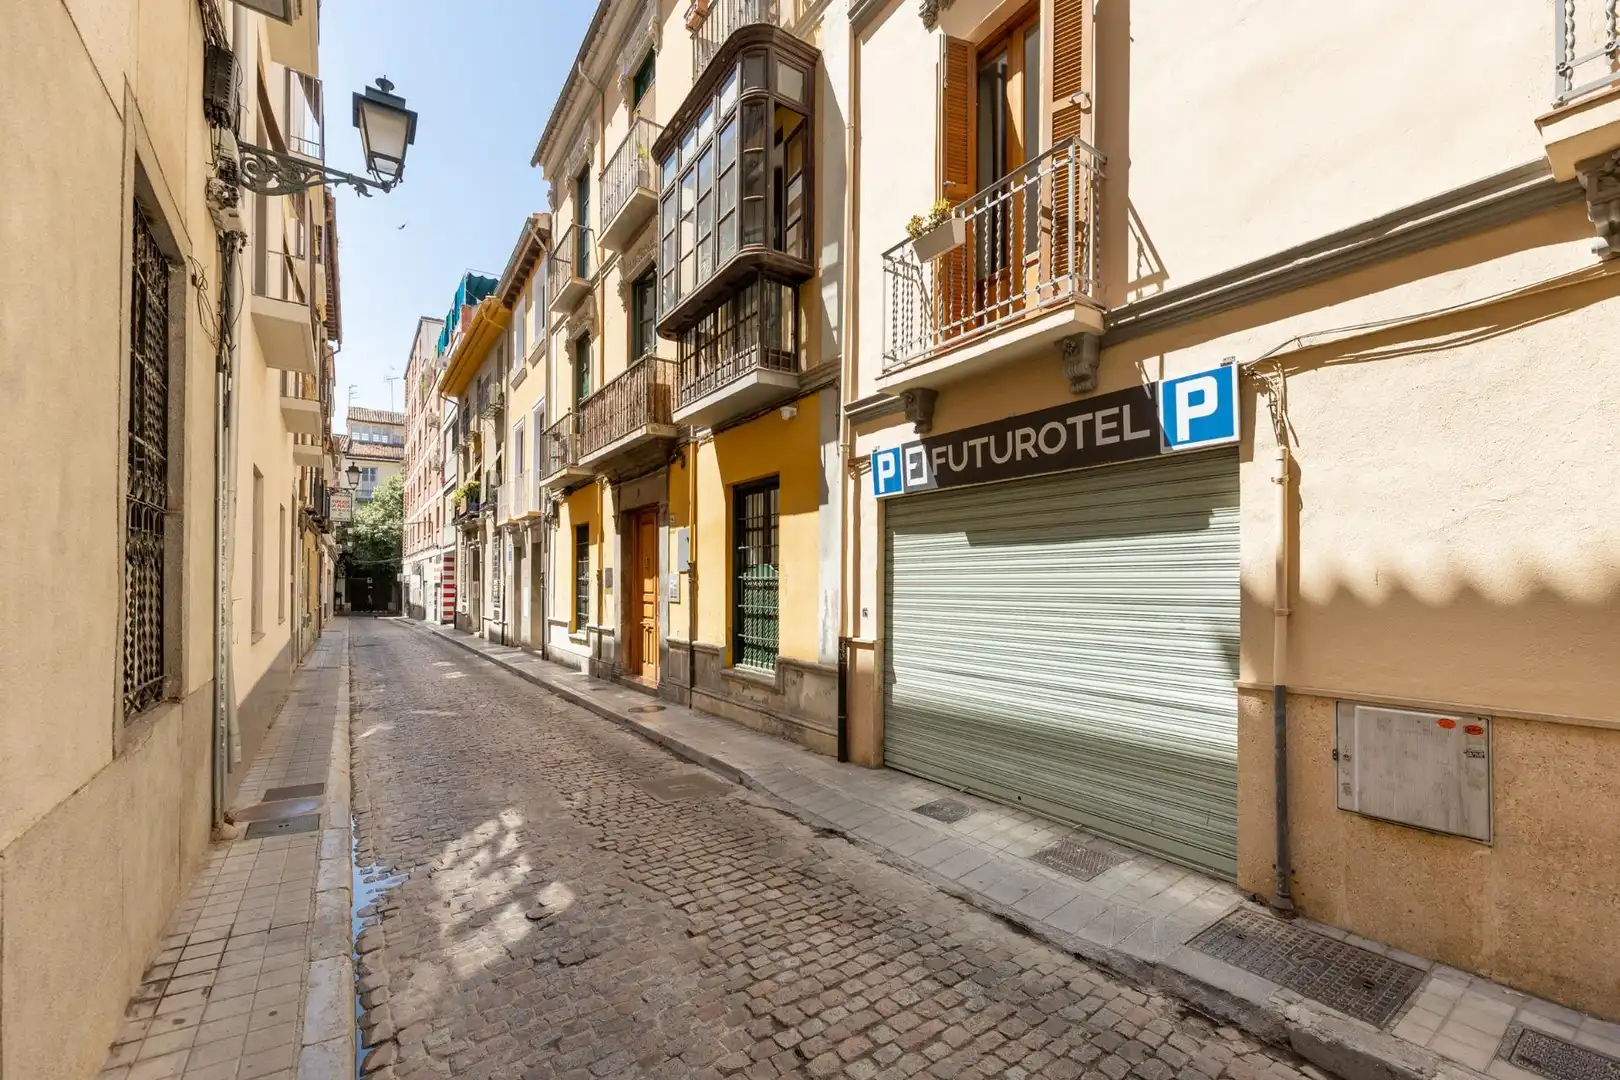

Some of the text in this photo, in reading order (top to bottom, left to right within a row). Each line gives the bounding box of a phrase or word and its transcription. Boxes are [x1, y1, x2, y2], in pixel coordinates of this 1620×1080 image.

[932, 404, 1151, 476] FUTUROTEL
[1176, 376, 1218, 442] P
[878, 452, 896, 493] P
